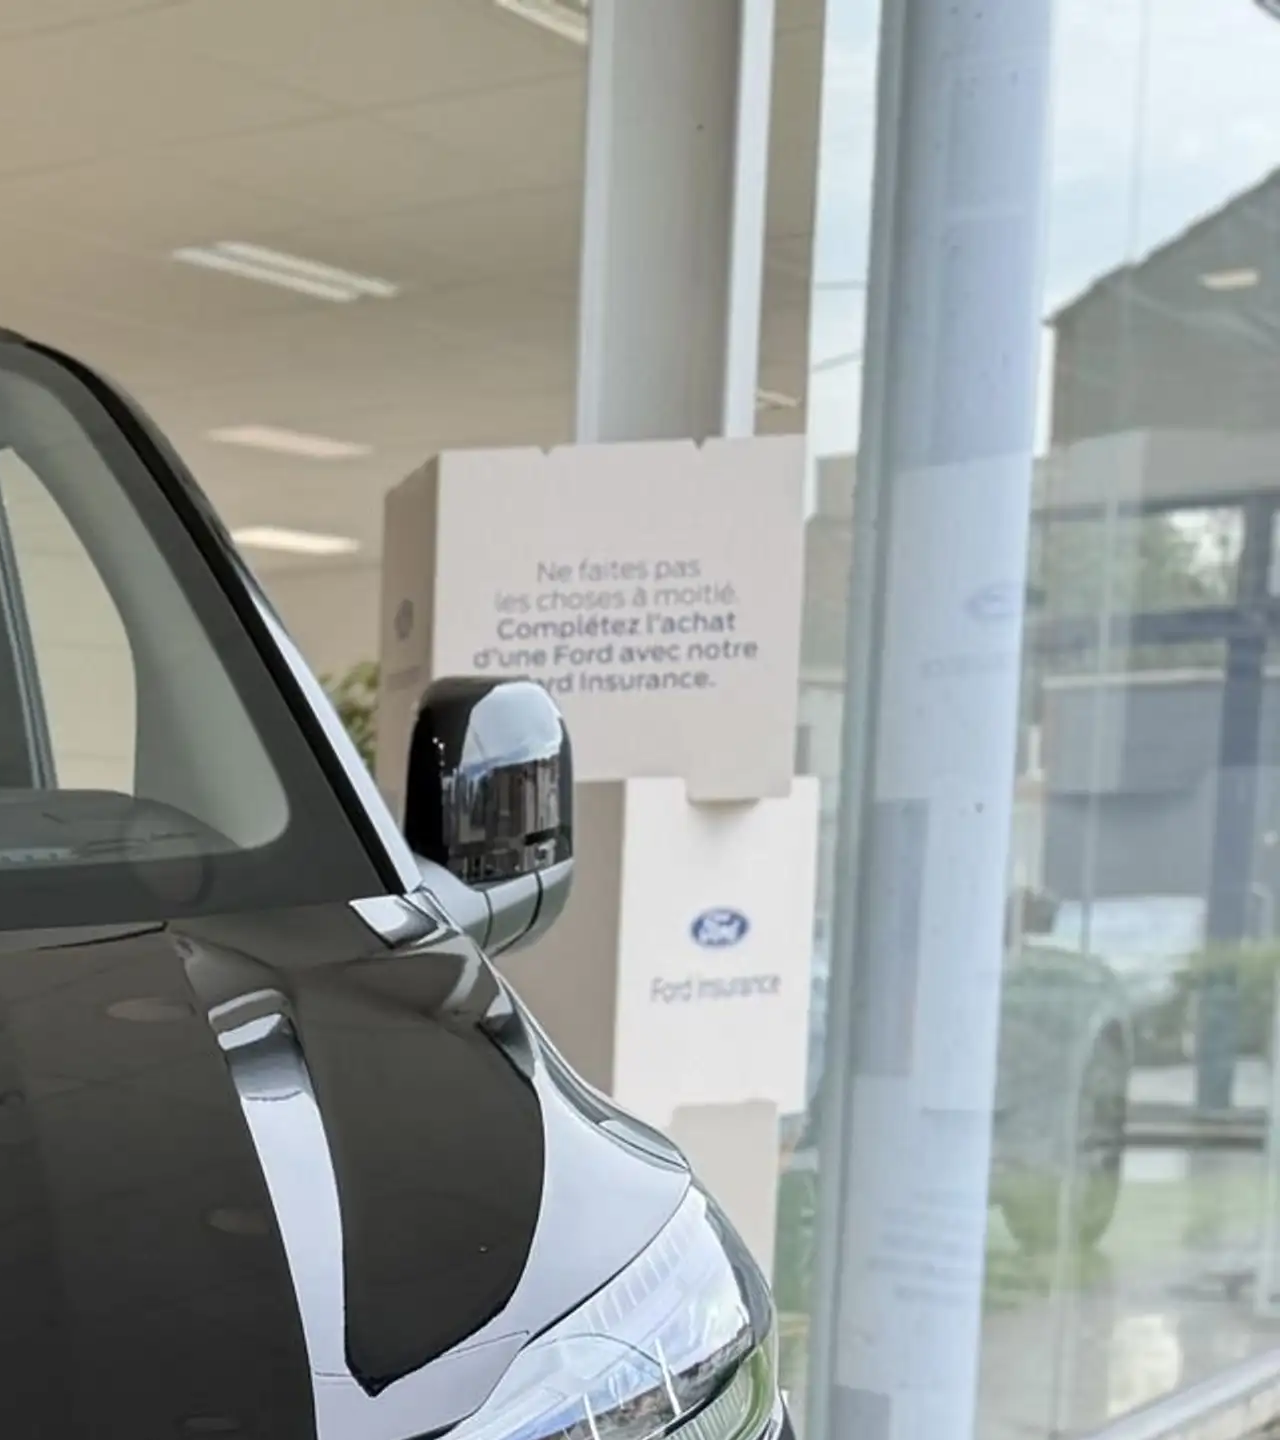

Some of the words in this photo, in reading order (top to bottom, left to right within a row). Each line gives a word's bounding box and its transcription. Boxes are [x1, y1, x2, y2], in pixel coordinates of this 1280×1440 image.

[536, 561, 572, 582] Ne
[578, 557, 649, 581] faites
[654, 558, 701, 581] pas
[493, 589, 531, 613] les
[535, 586, 626, 612] choses
[496, 613, 640, 641] Complétez
[645, 610, 737, 635] l'achat
[472, 649, 547, 669] d'une
[552, 644, 613, 666] Ford
[618, 644, 681, 663] avec
[686, 640, 759, 661] notre
